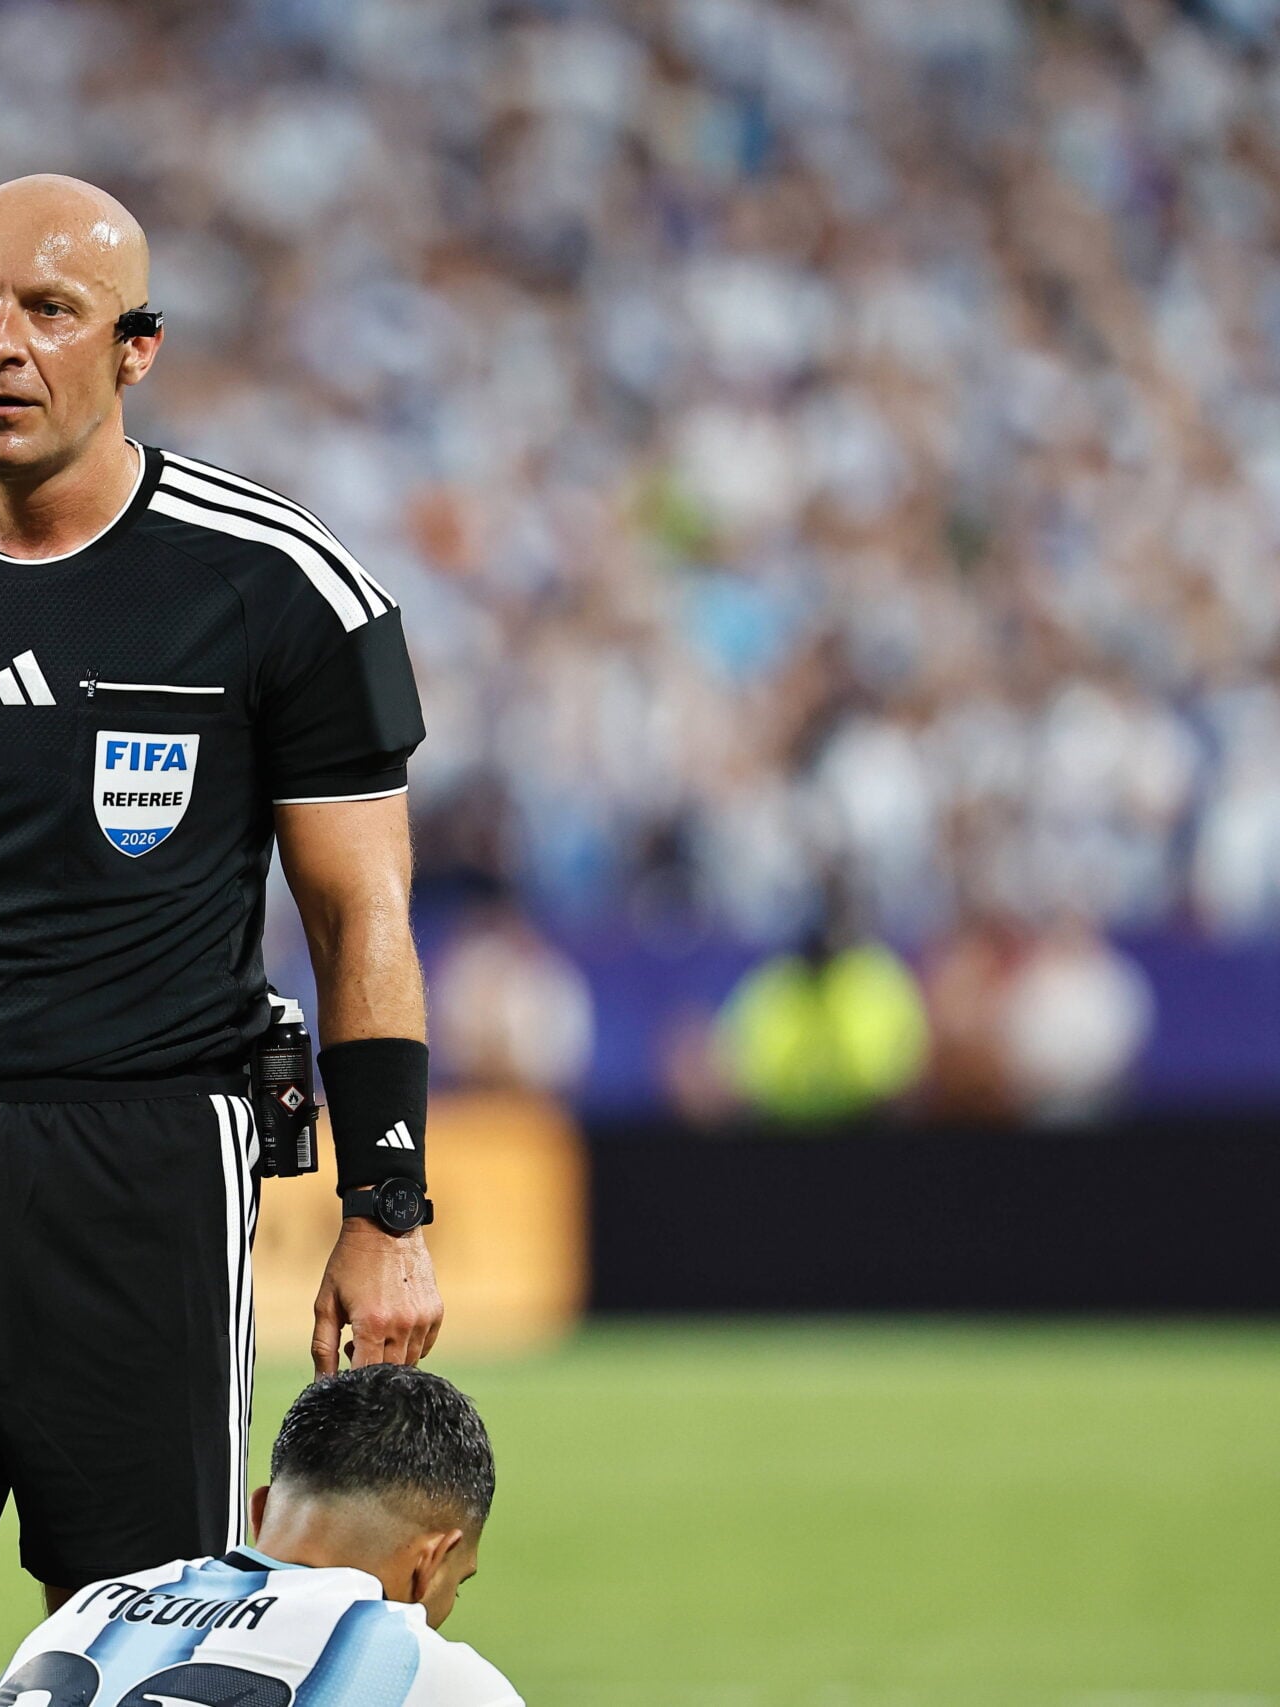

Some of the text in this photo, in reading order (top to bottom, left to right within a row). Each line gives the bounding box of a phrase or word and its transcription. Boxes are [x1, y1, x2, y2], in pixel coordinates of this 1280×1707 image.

[105, 740, 188, 772] FIFA
[102, 791, 184, 807] REFEREE
[120, 832, 157, 846] 2026
[76, 1582, 279, 1630] MEDINA
